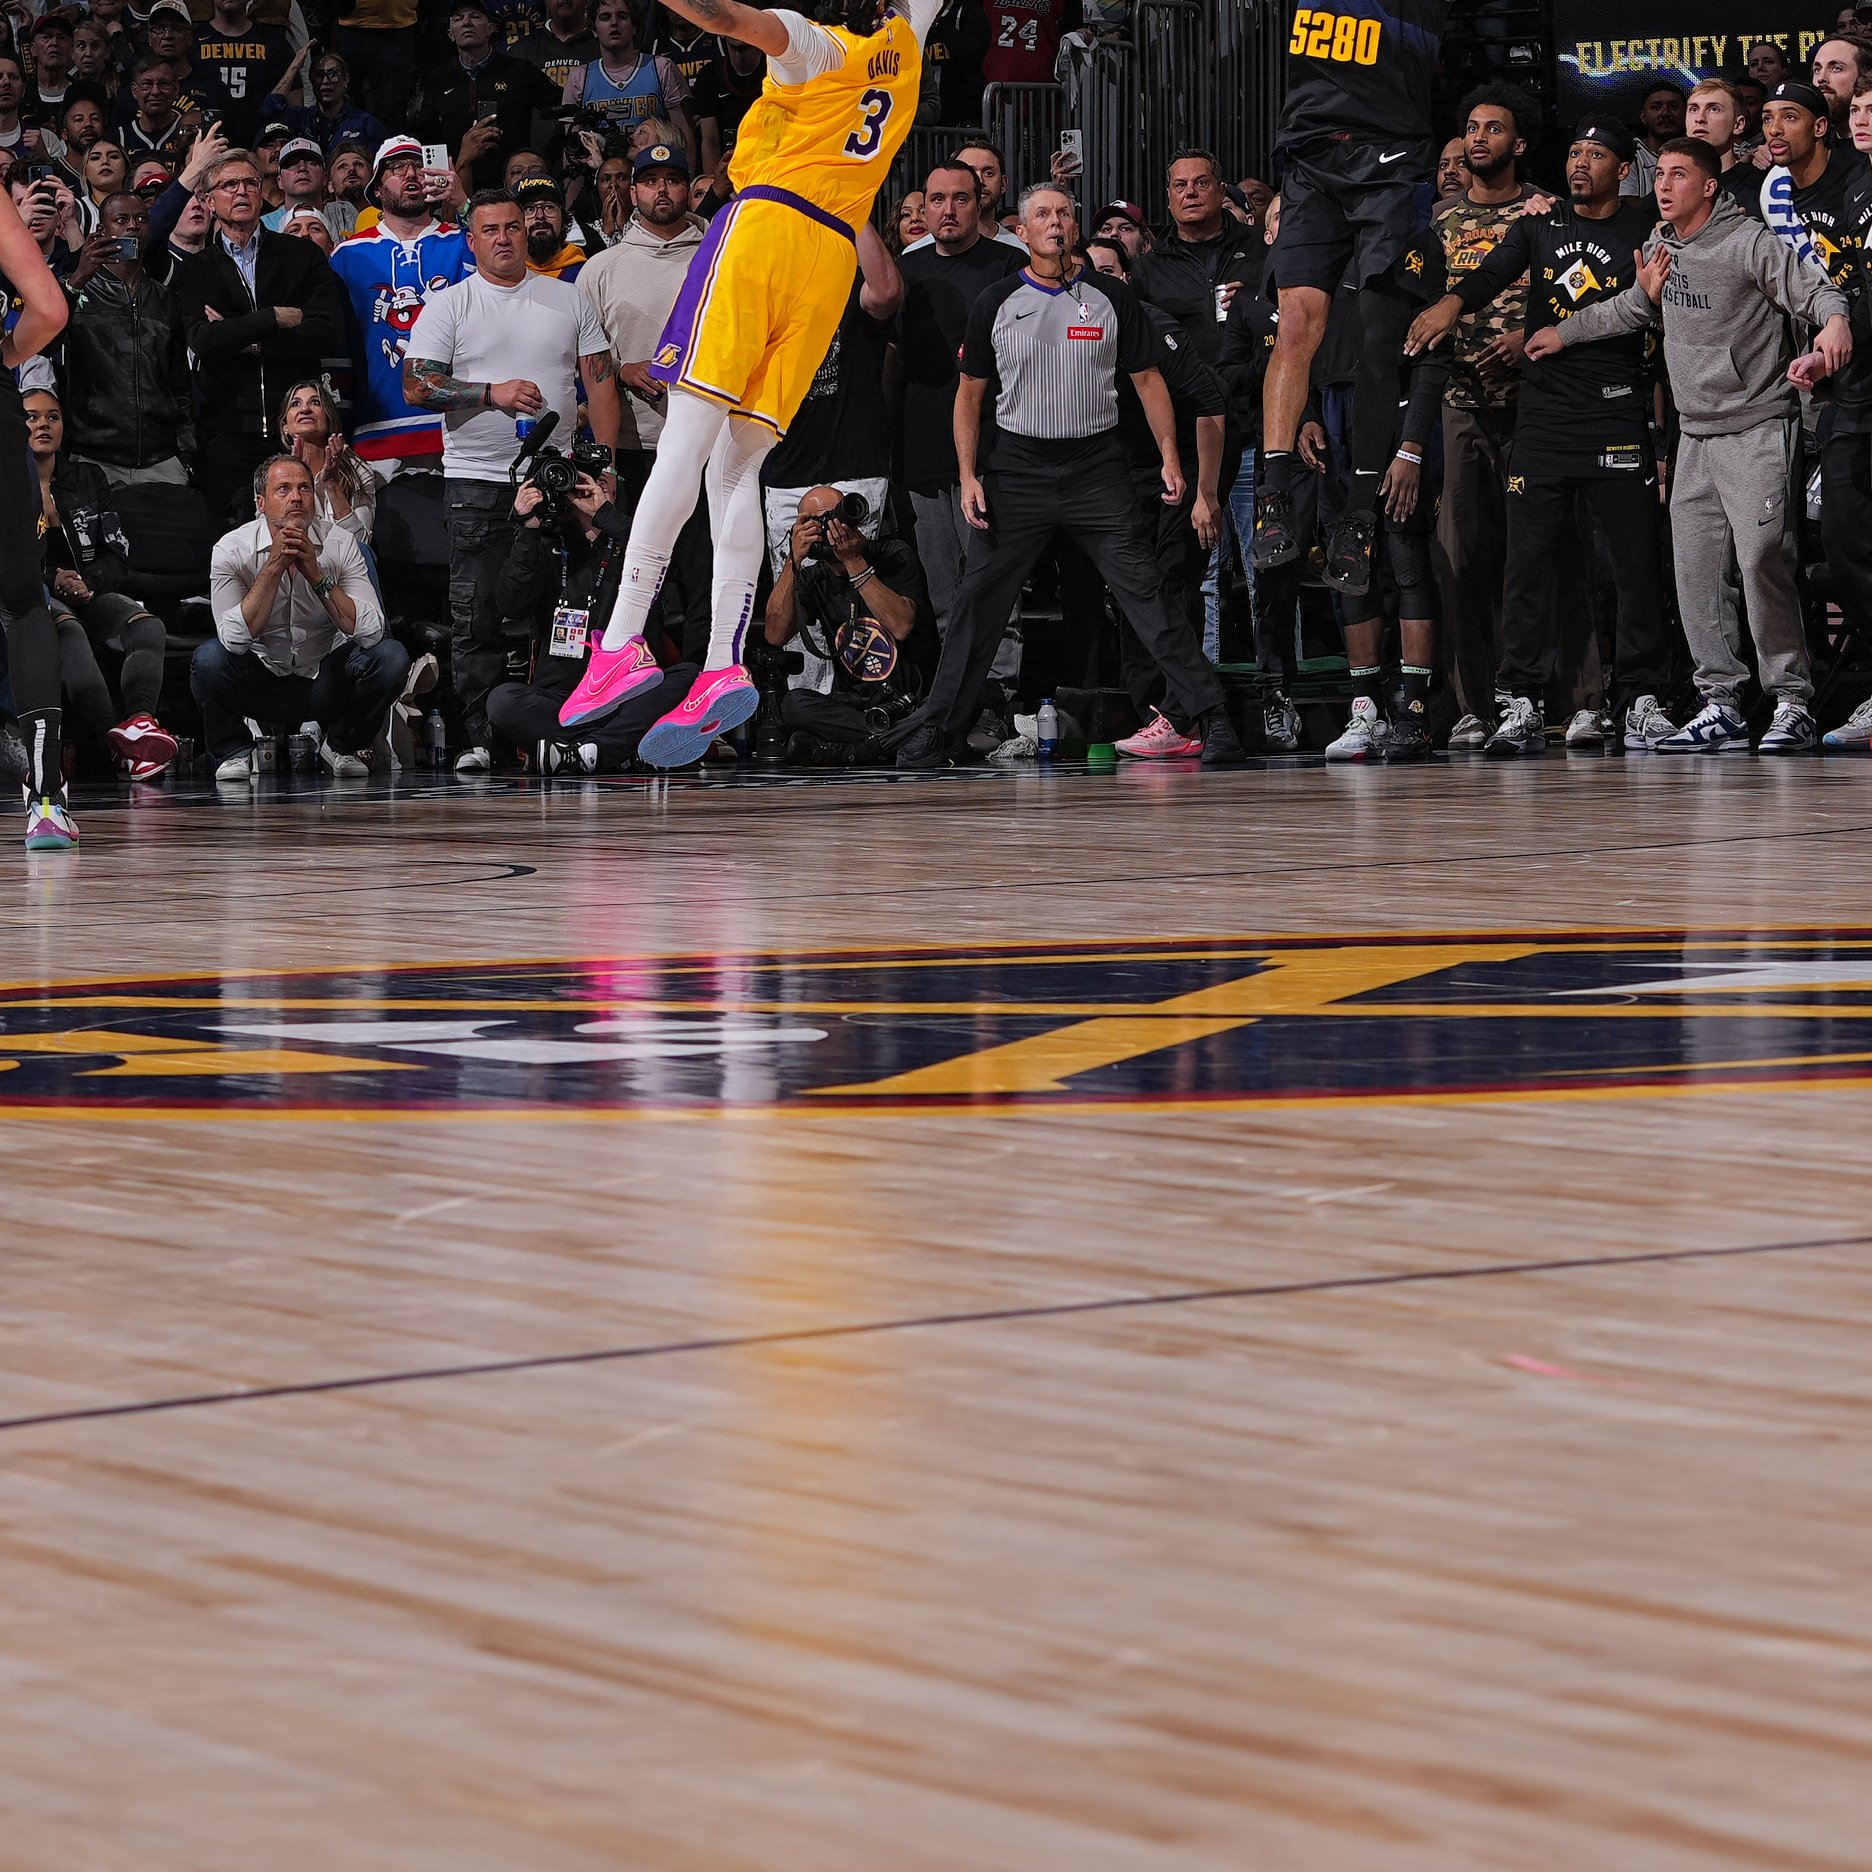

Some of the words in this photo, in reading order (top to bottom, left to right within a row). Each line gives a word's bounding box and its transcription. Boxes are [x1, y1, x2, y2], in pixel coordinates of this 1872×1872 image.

[997, 17, 1036, 50] 24
[1289, 10, 1383, 66] 5280
[200, 42, 266, 62] DENVER
[1576, 34, 1728, 74] ELECTRIFY
[544, 59, 581, 70] DENVER
[868, 50, 902, 80] DAVIS
[220, 66, 247, 98] 15
[842, 89, 894, 160] 3
[1811, 211, 1836, 228] HIGH
[1839, 235, 1852, 248] 24
[1555, 241, 1582, 259] MILE
[1586, 242, 1612, 265] HIGH
[1543, 267, 1553, 280] 20
[1605, 276, 1617, 288] 24
[1072, 329, 1099, 338] Emirates
[1264, 335, 1275, 346] 20
